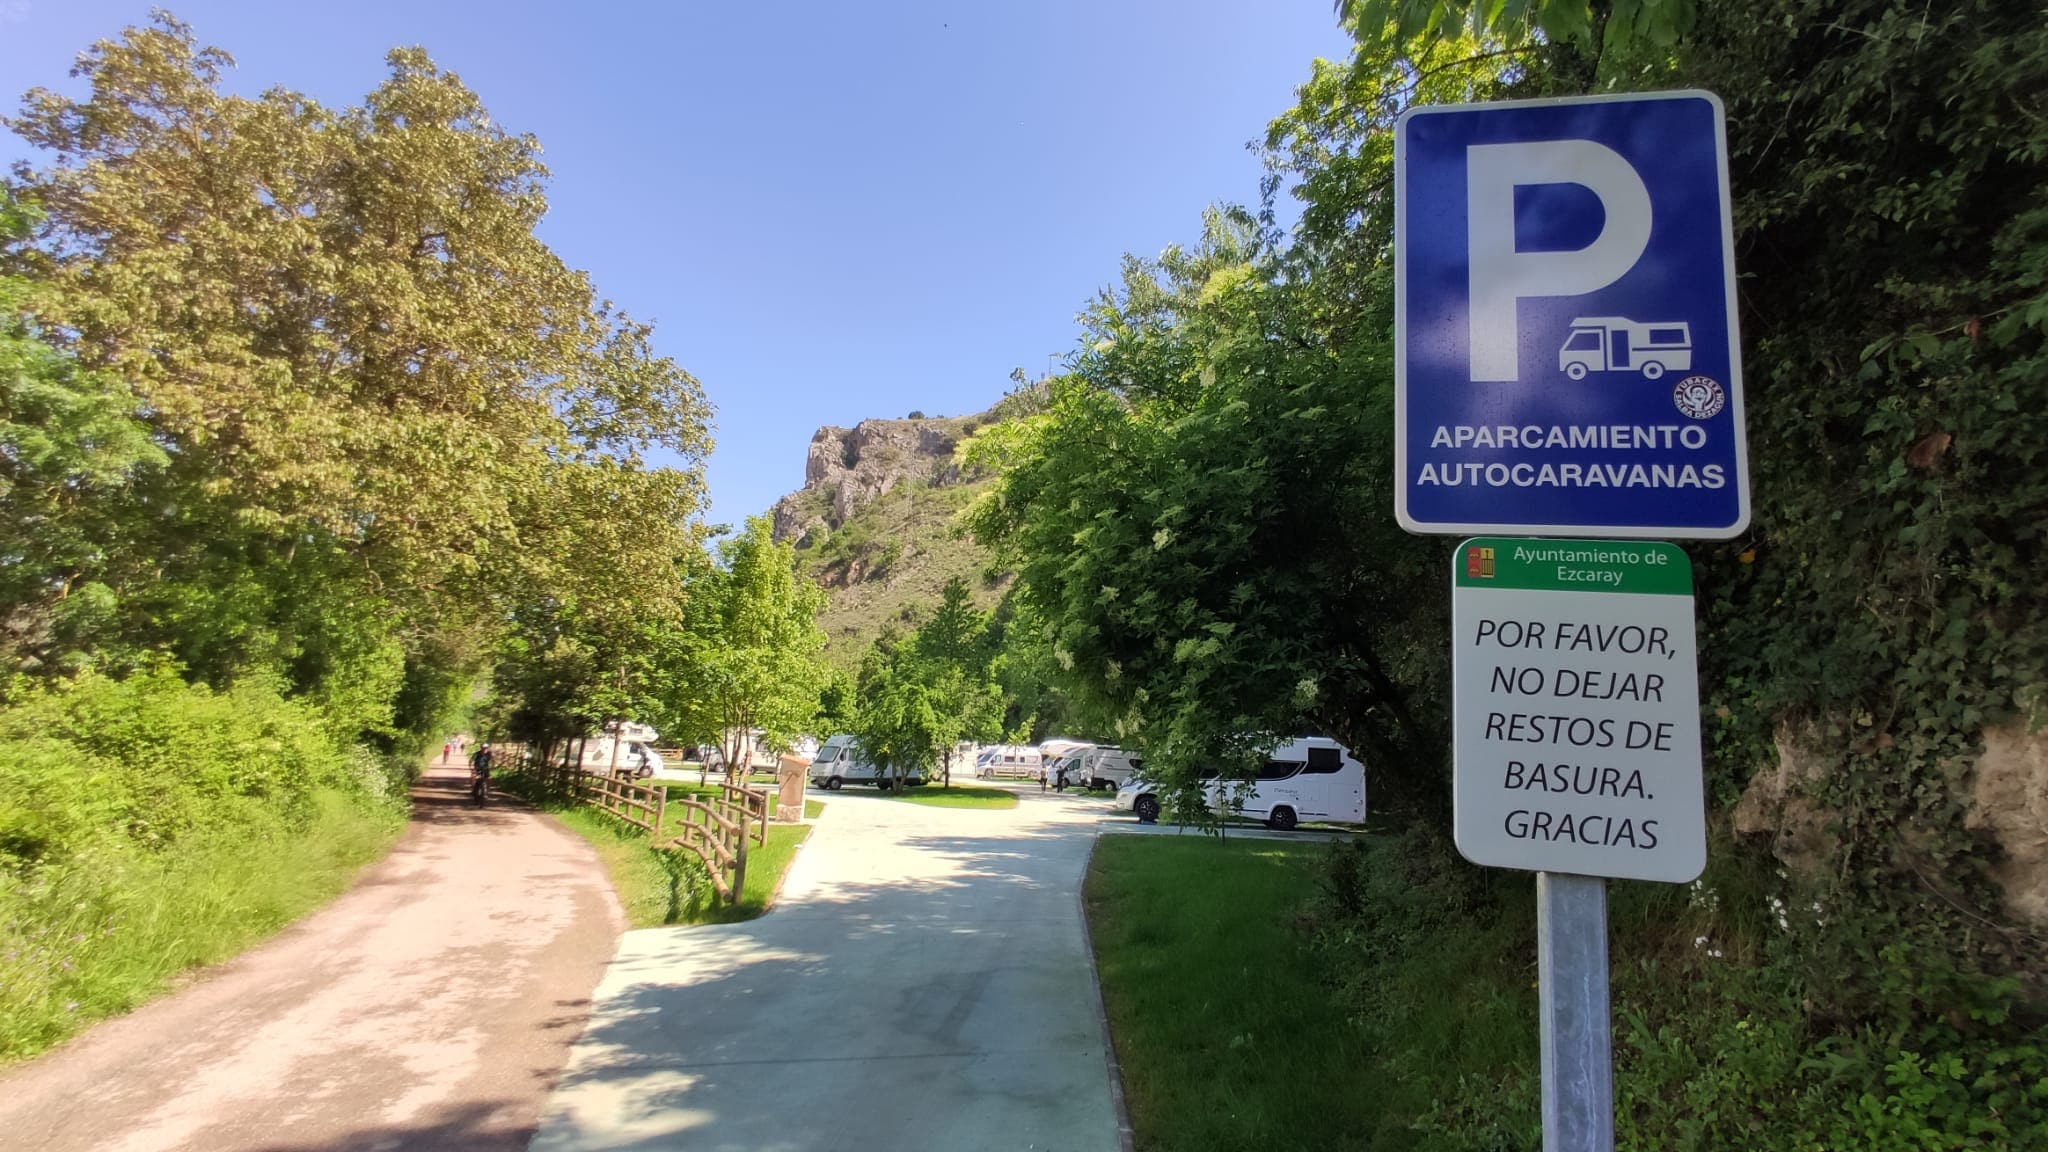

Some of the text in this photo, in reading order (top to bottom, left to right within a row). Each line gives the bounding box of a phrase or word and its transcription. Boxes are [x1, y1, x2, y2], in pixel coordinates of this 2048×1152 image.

[1467, 139, 1652, 381] P
[1431, 425, 1707, 449] APARCAMIENTO
[1417, 463, 1725, 489] AUTOCARAVANAS
[1514, 546, 1668, 567] Ayuntamiento de
[1557, 567, 1624, 585] Ezcaray
[1475, 620, 1676, 660] POR FAVOR,
[1491, 666, 1665, 702] NO DEJAR
[1485, 713, 1674, 751] RESTOS DE
[1504, 761, 1654, 799] BASURA.
[1505, 810, 1659, 850] GRACIAS
